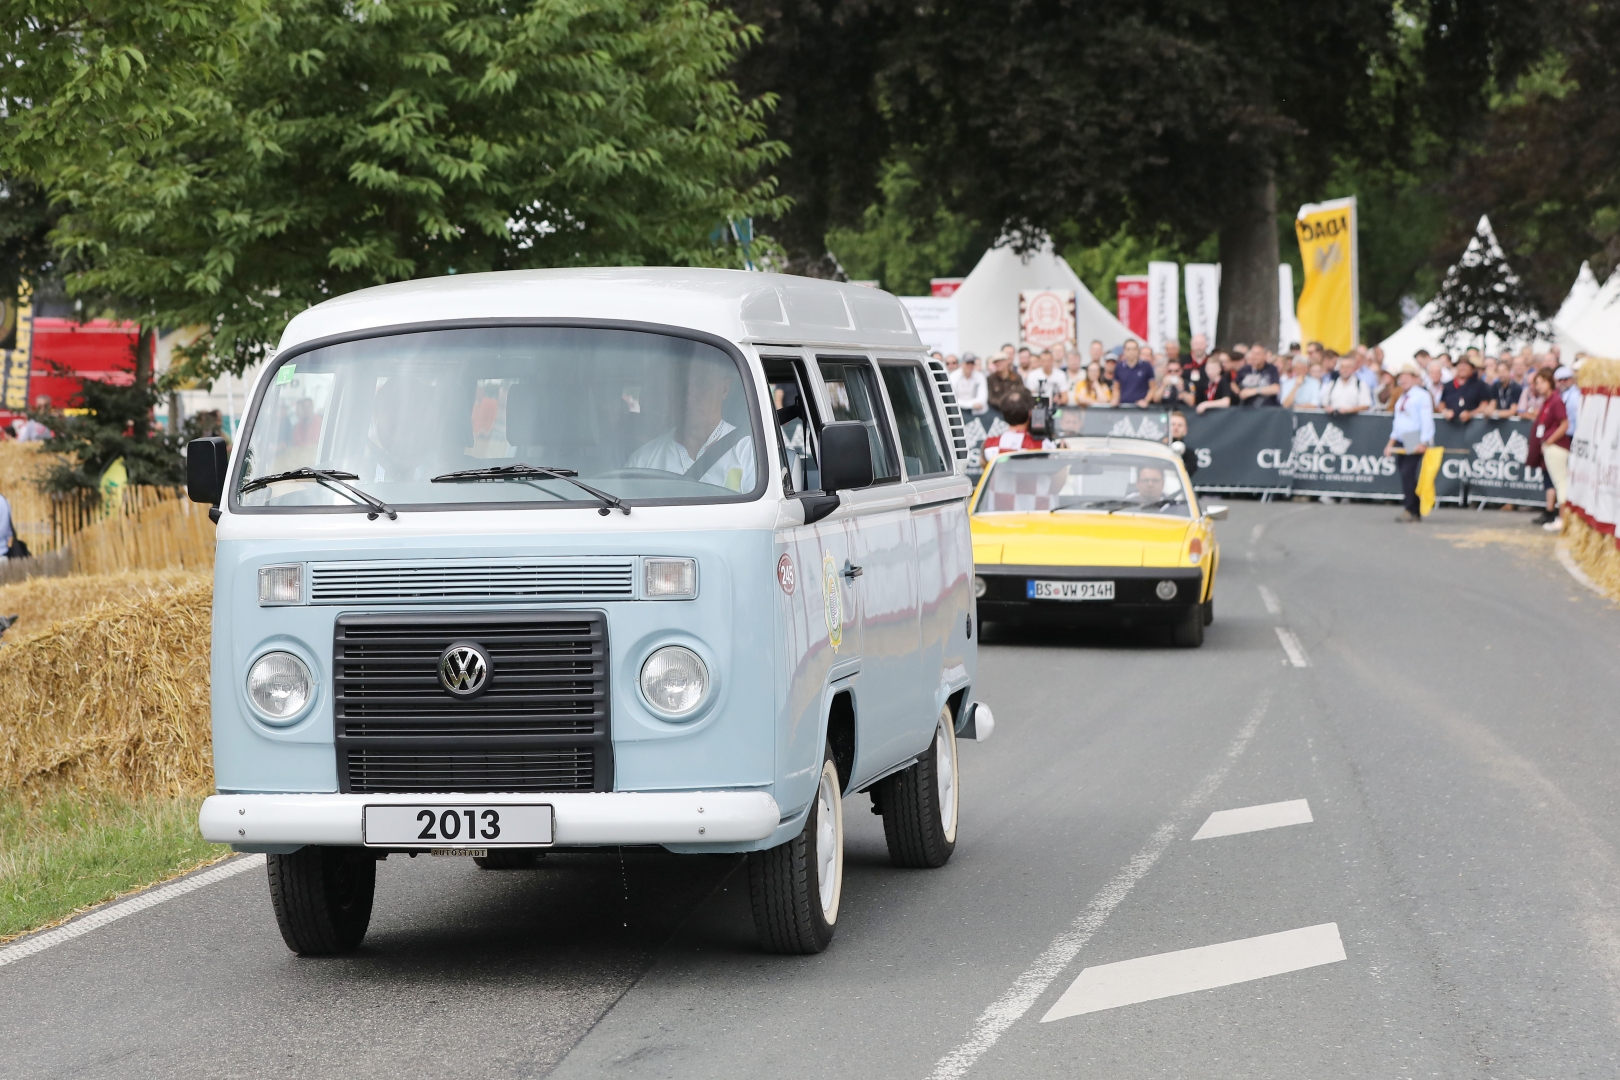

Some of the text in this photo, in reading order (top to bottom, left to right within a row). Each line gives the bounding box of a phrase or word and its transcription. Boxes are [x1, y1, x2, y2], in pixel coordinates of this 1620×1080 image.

[1340, 455, 1397, 477] DAYS
[781, 565, 794, 585] 245
[1036, 583, 1113, 597] BS VW 914H
[441, 646, 487, 695] VW
[416, 809, 501, 840] 2013
[433, 849, 486, 857] AUTOSTADT
